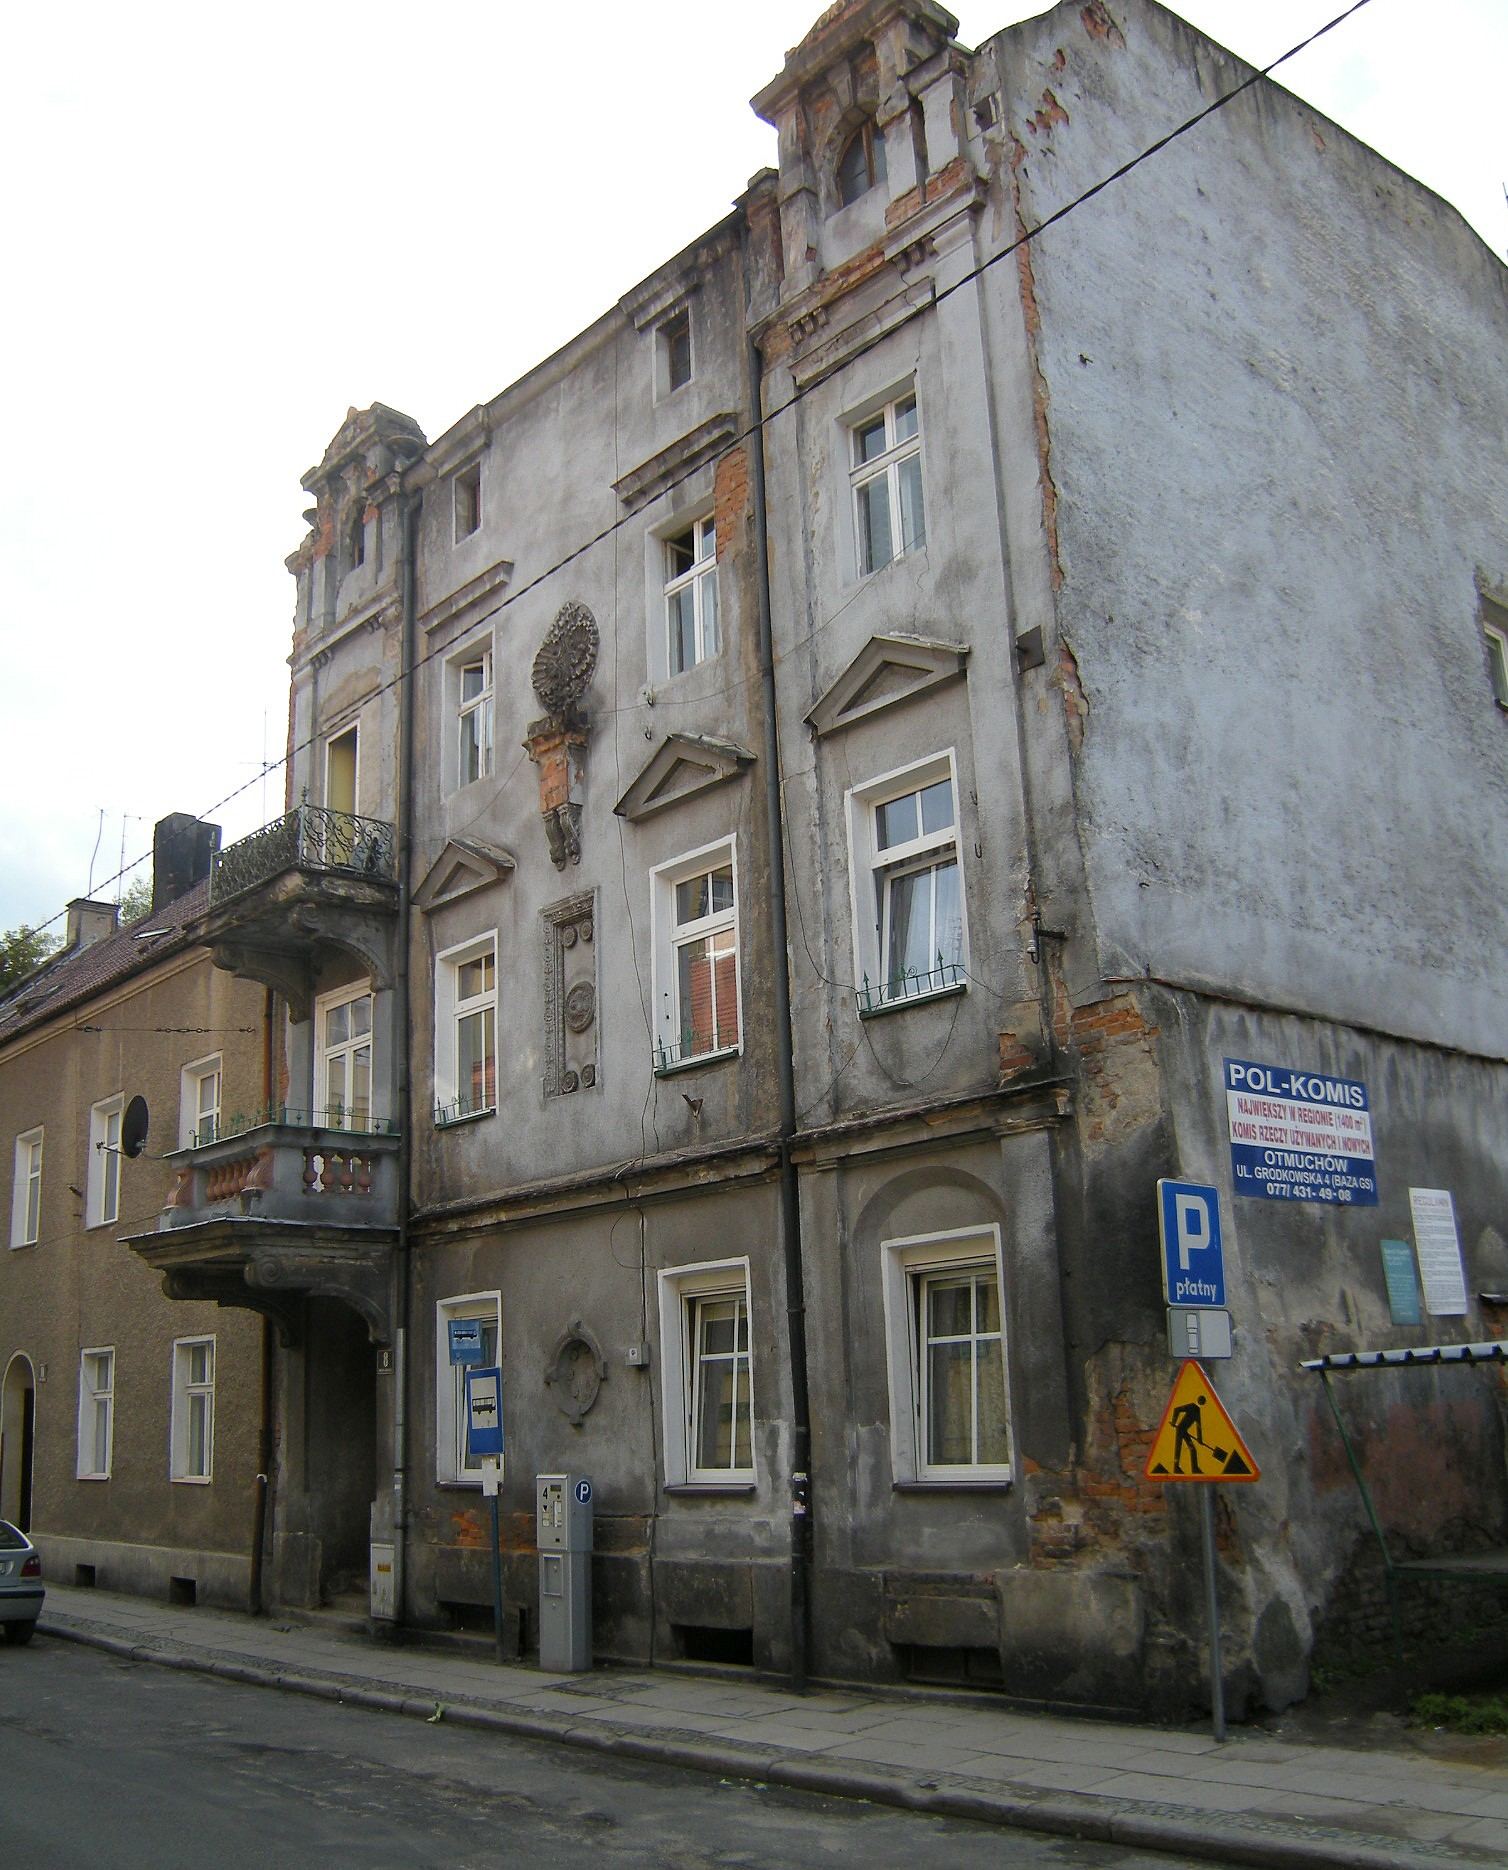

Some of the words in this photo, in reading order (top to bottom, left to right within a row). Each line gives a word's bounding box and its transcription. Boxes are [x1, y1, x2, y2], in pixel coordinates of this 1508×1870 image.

[1229, 1063, 1364, 1107] POL-KOMIS
[1237, 1097, 1287, 1121] NAJWIĘKSZY
[1289, 1105, 1296, 1122] W
[1297, 1107, 1334, 1126] REGIONIE
[1232, 1121, 1257, 1140] KOMIS
[1260, 1125, 1288, 1144] RZECZY
[1290, 1125, 1337, 1150] UŻYWANYCH
[1342, 1137, 1371, 1154] NOWYCH
[1264, 1150, 1348, 1173] OTMUCHÓW
[1236, 1165, 1252, 1178] UL.
[1254, 1166, 1323, 1185] GRODKOWSKA
[1324, 1176, 1331, 1185] 4
[1331, 1175, 1359, 1189] (BAZA
[1359, 1177, 1374, 1192] GS)
[1175, 1193, 1210, 1270] P
[1176, 1277, 1217, 1302] płatny
[542, 1486, 548, 1500] 4
[580, 1483, 589, 1501] P
